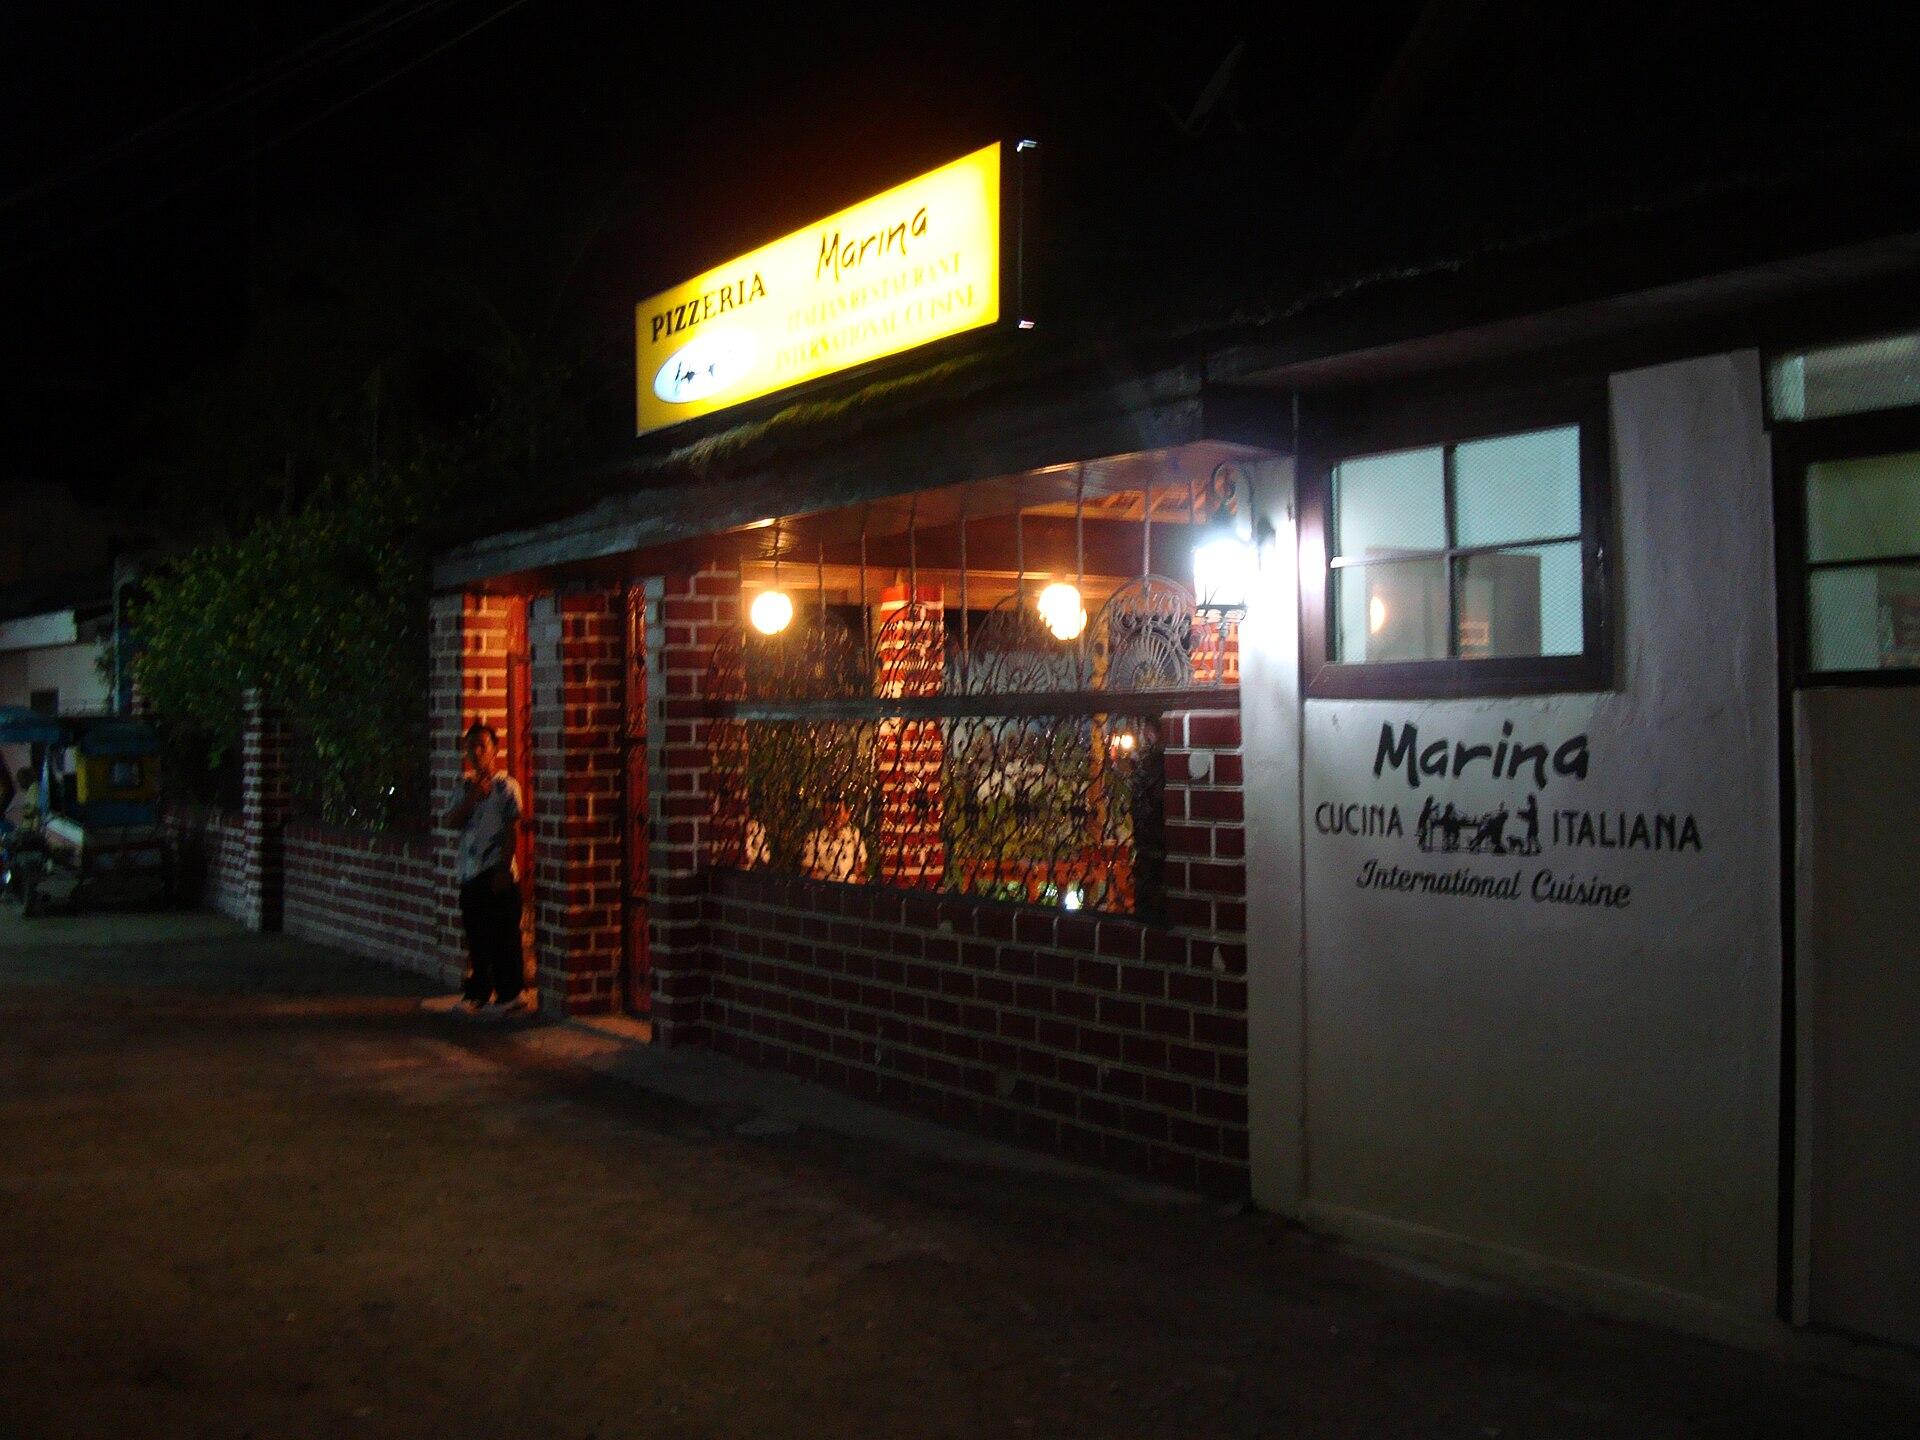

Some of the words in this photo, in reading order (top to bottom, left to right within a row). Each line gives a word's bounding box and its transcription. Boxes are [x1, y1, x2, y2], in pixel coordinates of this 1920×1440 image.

[816, 204, 928, 281] Marina
[651, 272, 768, 342] PIZZERIA
[1373, 720, 1589, 788] Marina
[1315, 801, 1403, 837] CUCINA
[1554, 811, 1702, 852] ITALIANA
[1357, 859, 1522, 901] International
[1532, 869, 1632, 908] Cuisine
